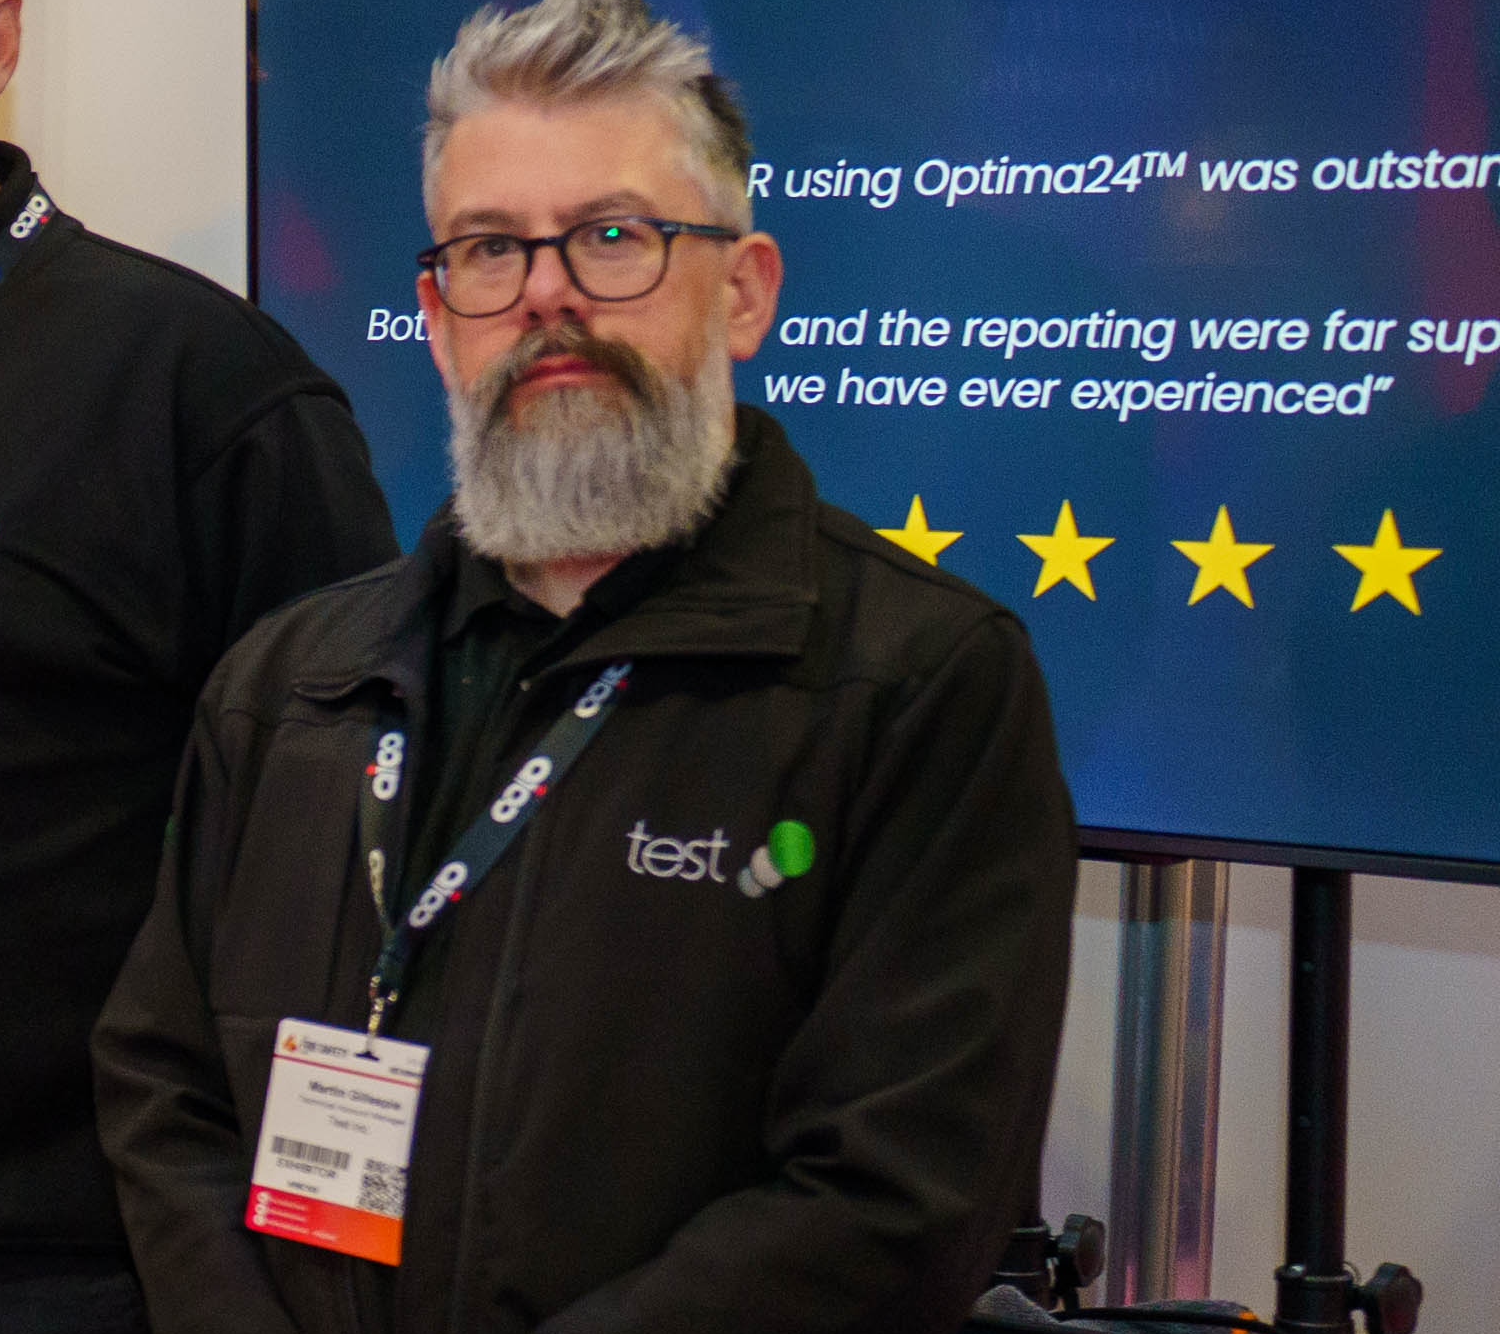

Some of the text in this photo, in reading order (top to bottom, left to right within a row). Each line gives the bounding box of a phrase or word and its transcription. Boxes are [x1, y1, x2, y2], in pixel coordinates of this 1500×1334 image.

[784, 159, 900, 208] using
[1199, 158, 1298, 193] was
[1312, 149, 1500, 190] outstan
[367, 308, 1500, 366] Bot and the reporting were far sup
[765, 372, 825, 403] we
[836, 367, 946, 407] have
[959, 376, 1061, 410] ever
[491, 755, 553, 824] aico
[625, 820, 730, 884] test
